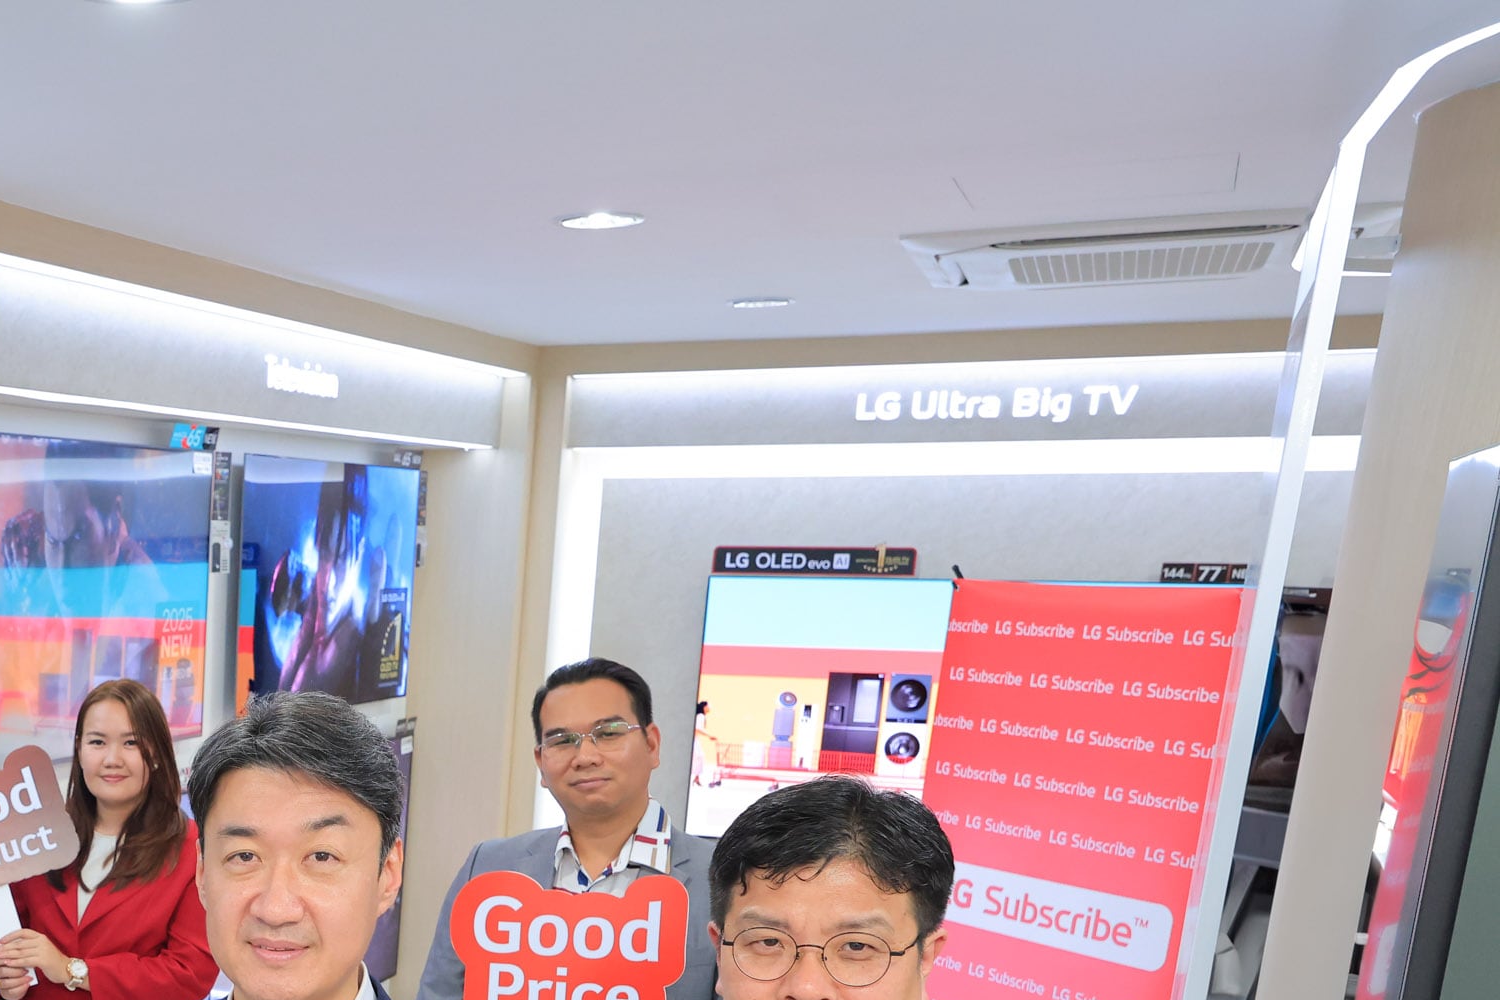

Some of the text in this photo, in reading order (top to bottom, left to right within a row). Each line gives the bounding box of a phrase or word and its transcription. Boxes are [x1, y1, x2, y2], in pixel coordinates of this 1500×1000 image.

[855, 384, 1140, 423] LG Ultra Big TV
[725, 552, 749, 569] LG
[755, 552, 806, 569] OLED
[807, 559, 831, 569] evo
[162, 607, 194, 633] 2025
[995, 621, 1011, 635] LG
[1015, 622, 1075, 639] Subscribe
[1083, 624, 1101, 640] LG
[1106, 626, 1174, 644] Subscribe
[1183, 630, 1205, 646] LG
[160, 633, 192, 659] NEW
[950, 667, 1220, 704] LG Subscribe LG Subscribe LG Subscribe
[980, 718, 996, 733] LG
[1000, 721, 1058, 740] Subscribe
[1066, 728, 1084, 743] LG
[1089, 731, 1155, 752] Subscribe
[1163, 739, 1184, 756] LG
[936, 760, 1199, 813] LG Subscribe LG Subscribe LG Subscribe
[965, 815, 981, 829] LG
[985, 818, 1041, 841] Subscribe
[1049, 830, 1067, 845] LG
[1071, 834, 1135, 858] Subscribe
[1144, 847, 1164, 863] LG
[947, 879, 972, 908] G
[473, 895, 662, 963] Good
[968, 963, 984, 978] LG
[988, 968, 1044, 995] Subscribe
